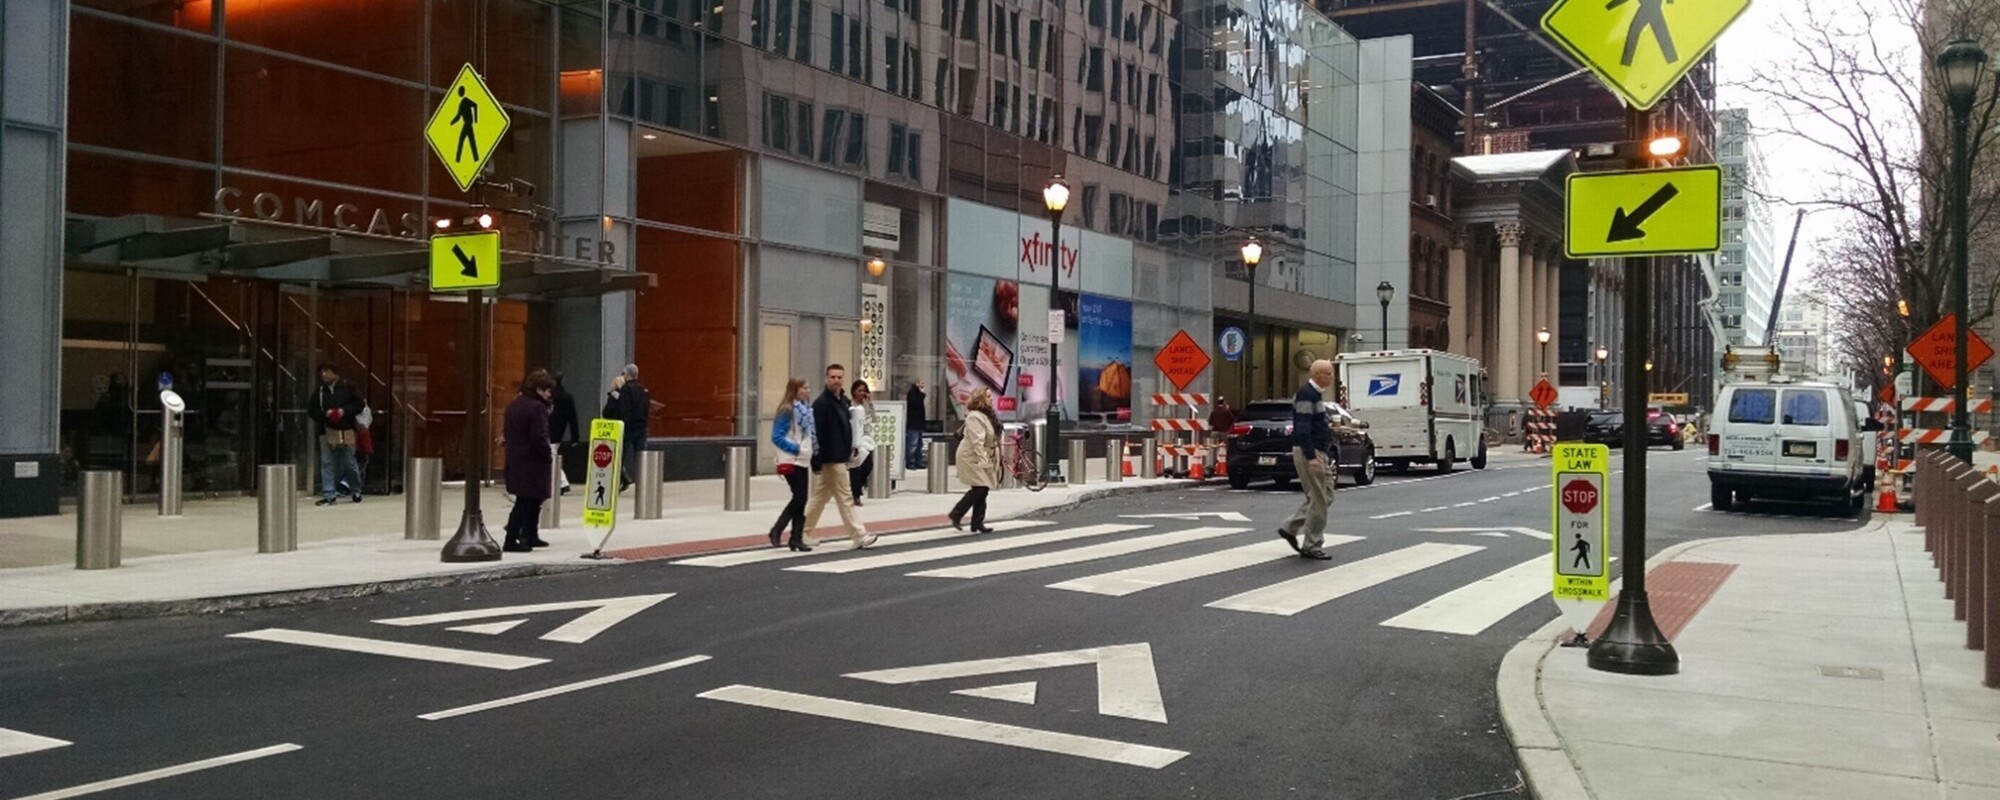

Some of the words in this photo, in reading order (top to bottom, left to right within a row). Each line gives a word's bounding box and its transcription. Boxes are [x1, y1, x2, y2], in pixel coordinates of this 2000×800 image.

[215, 187, 424, 238] COMCAS
[1021, 232, 1078, 278] xfinty
[1932, 332, 1955, 342] LAN
[1169, 346, 1195, 354] LANES
[1171, 356, 1192, 365] SHIFT
[1929, 360, 1954, 369] AHE
[1169, 367, 1195, 376] AHEAD
[595, 422, 615, 431] STATE
[594, 450, 611, 461] STOP
[1563, 447, 1598, 459] STATE
[1568, 460, 1592, 470] LAW
[1564, 490, 1596, 504] STOP
[1570, 520, 1589, 529] FOR
[1567, 578, 1593, 586] WITHIN
[1558, 586, 1603, 597] CROSSWALK
